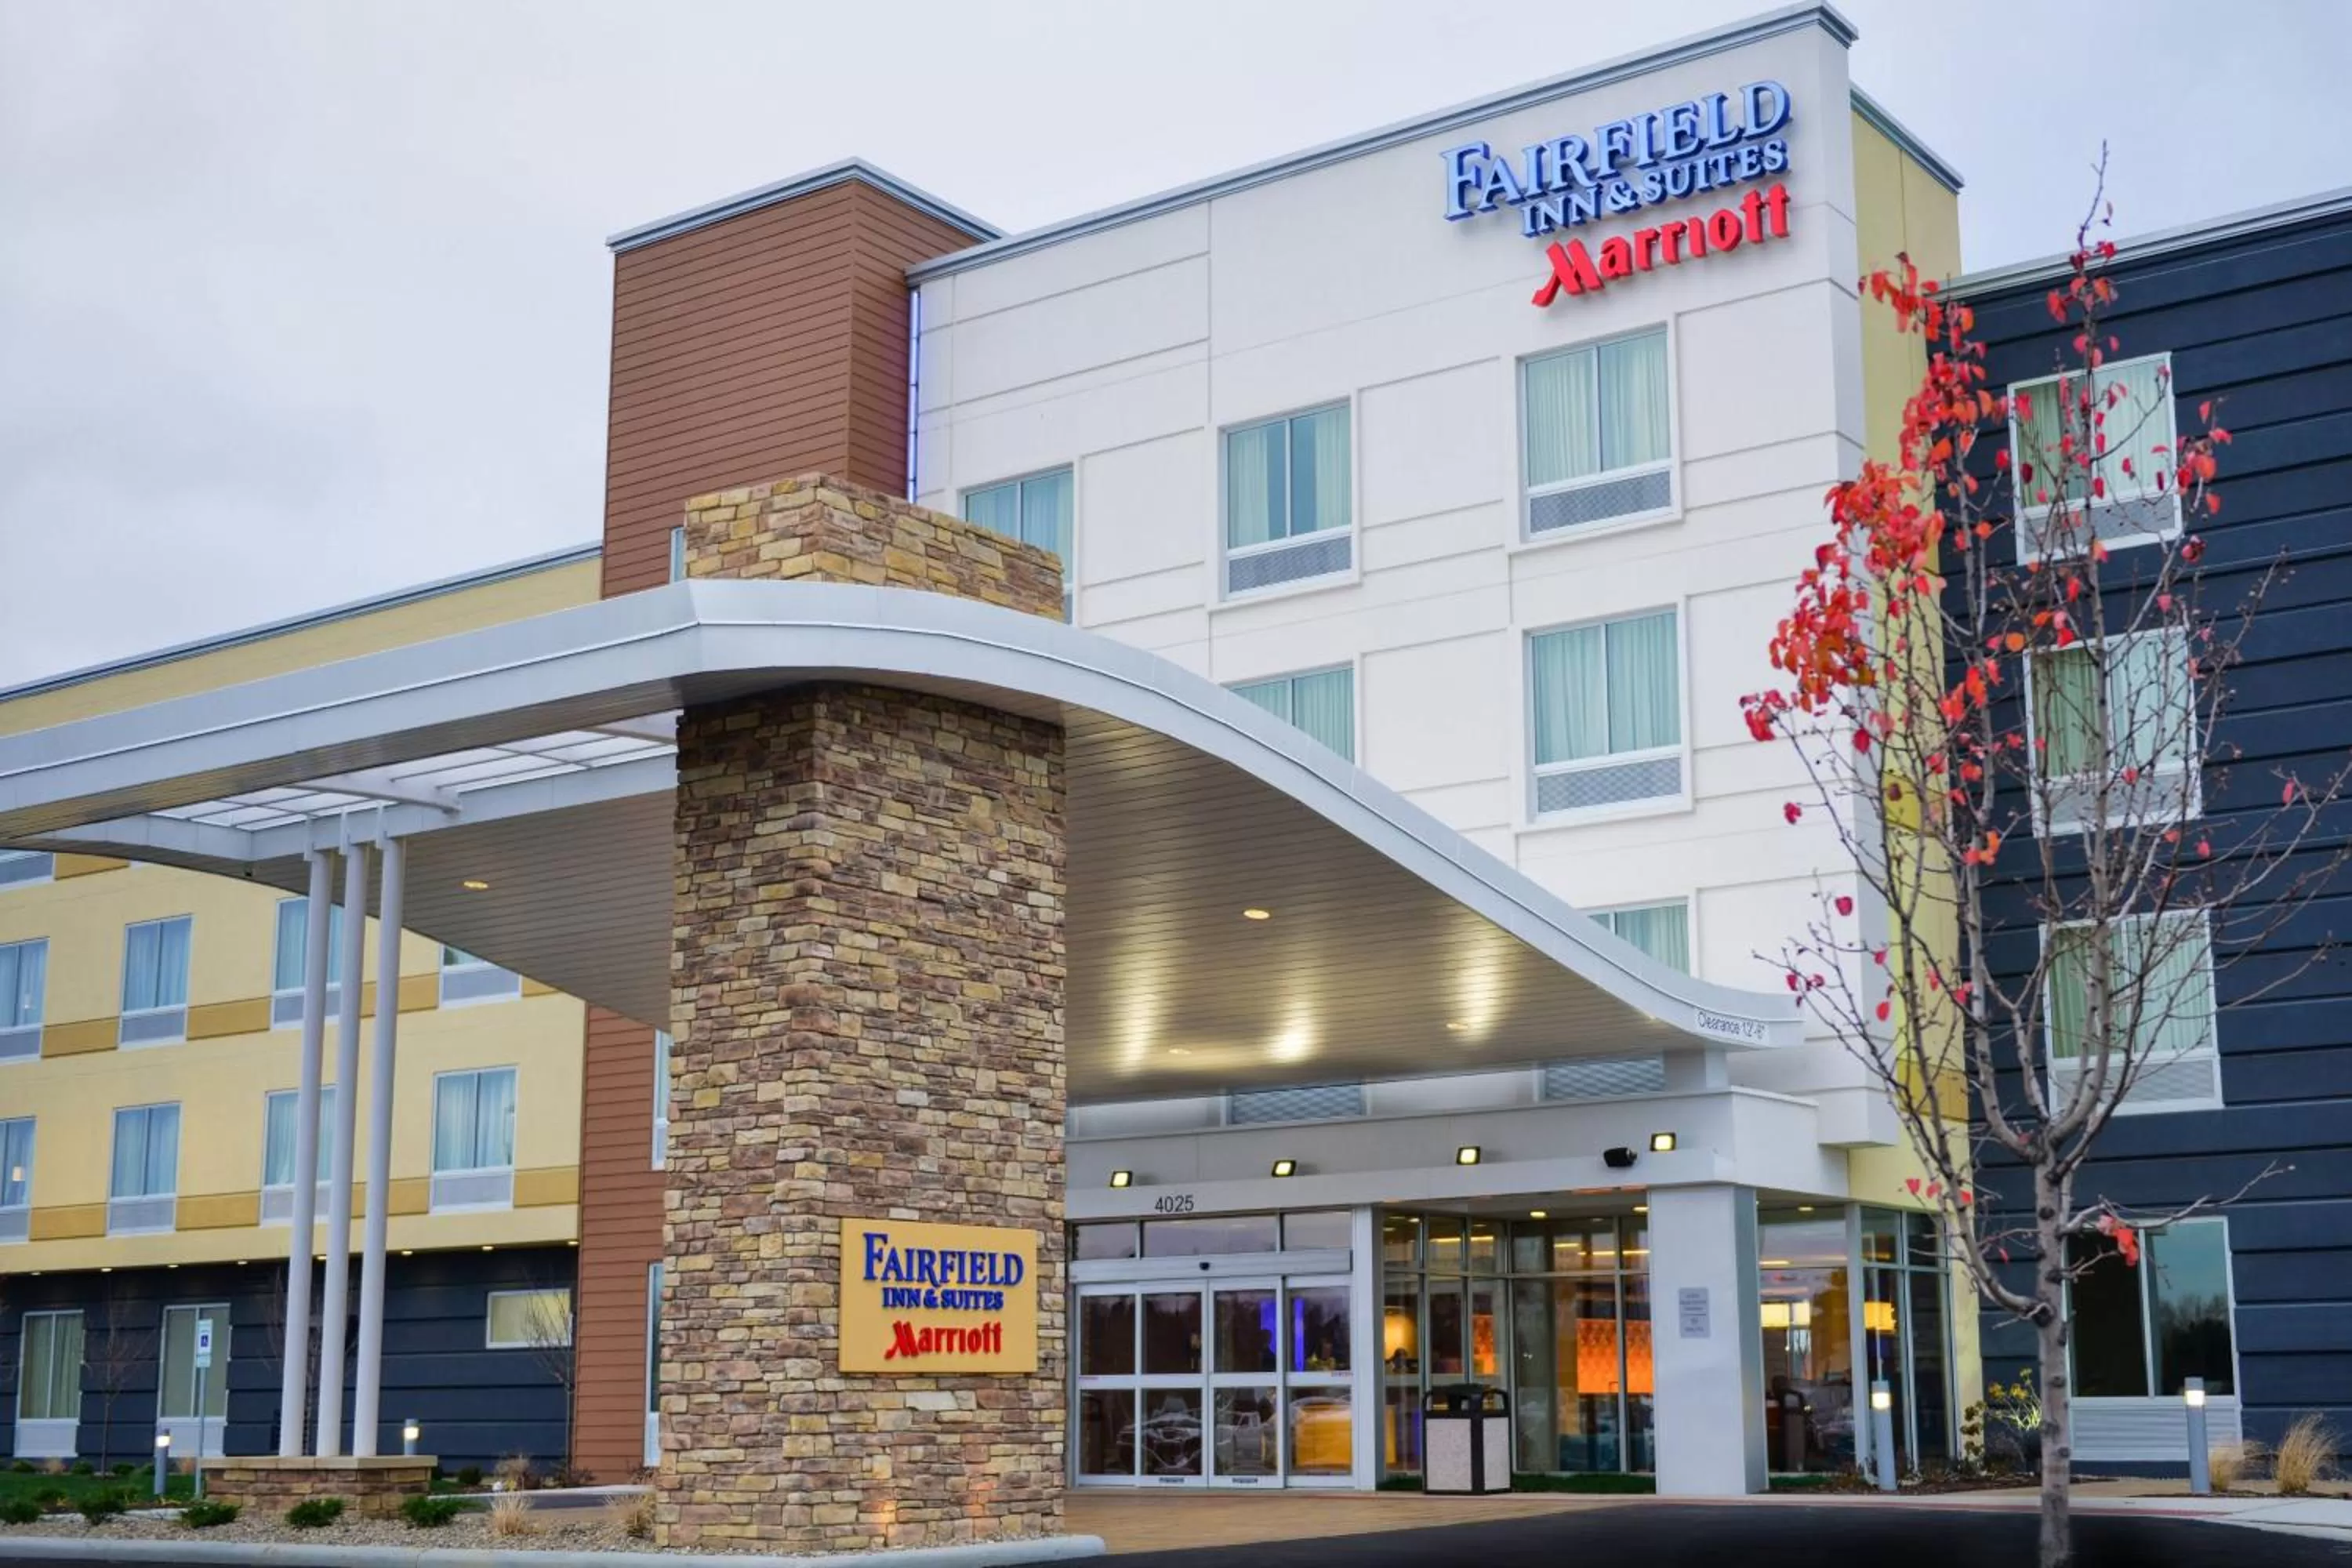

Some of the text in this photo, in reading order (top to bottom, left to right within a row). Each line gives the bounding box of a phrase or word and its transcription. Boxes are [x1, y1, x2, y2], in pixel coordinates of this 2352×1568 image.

[1439, 79, 1792, 221] FAIRFIELD
[1521, 186, 1602, 238] INN
[1642, 139, 1788, 205] SUITES
[1532, 182, 1790, 307] Marriott
[1697, 1011, 1741, 1035] Clearance
[1154, 1194, 1195, 1213] 4025
[862, 1232, 1024, 1287] FAIRFIELD
[882, 1287, 921, 1308] INN
[941, 1289, 1004, 1310] SUITES
[884, 1320, 1001, 1360] Marriott
